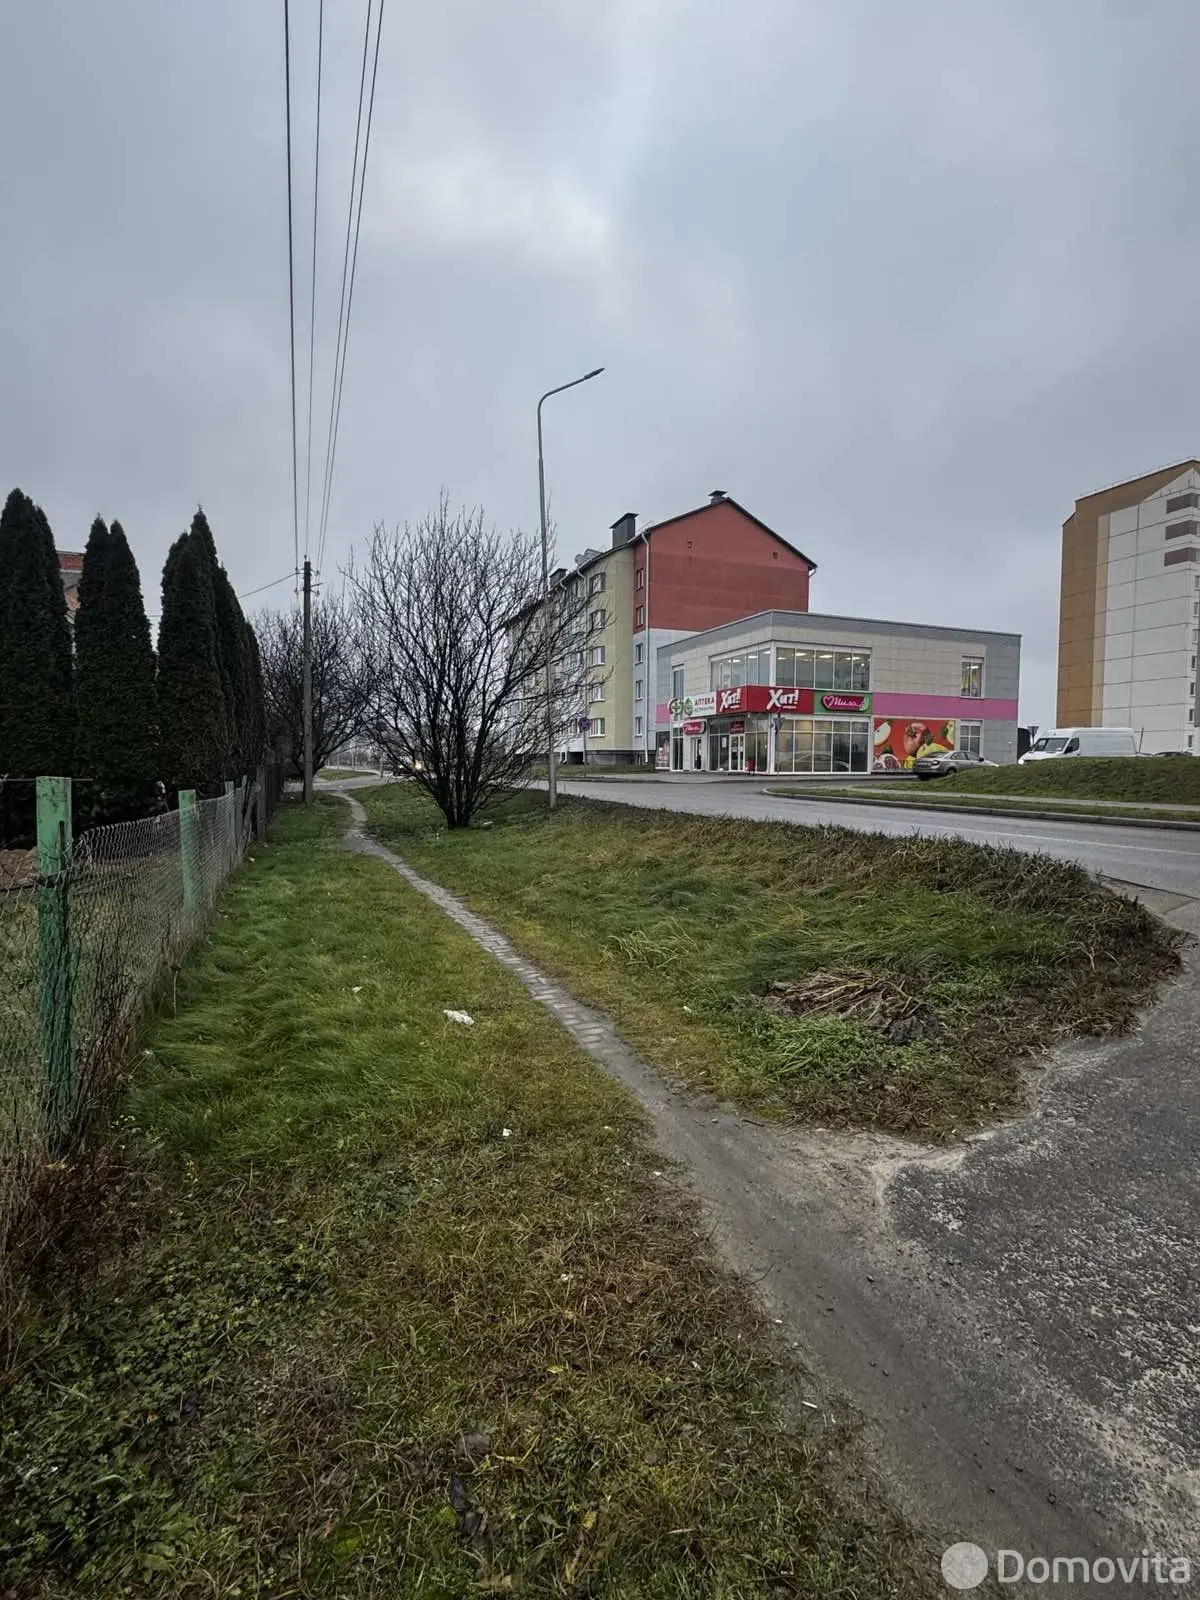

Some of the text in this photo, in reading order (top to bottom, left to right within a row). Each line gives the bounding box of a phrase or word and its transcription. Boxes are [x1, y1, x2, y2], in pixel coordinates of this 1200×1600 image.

[695, 697, 714, 706] АПТЕКА
[719, 688, 741, 712] Хит!
[766, 689, 799, 710] Хит!
